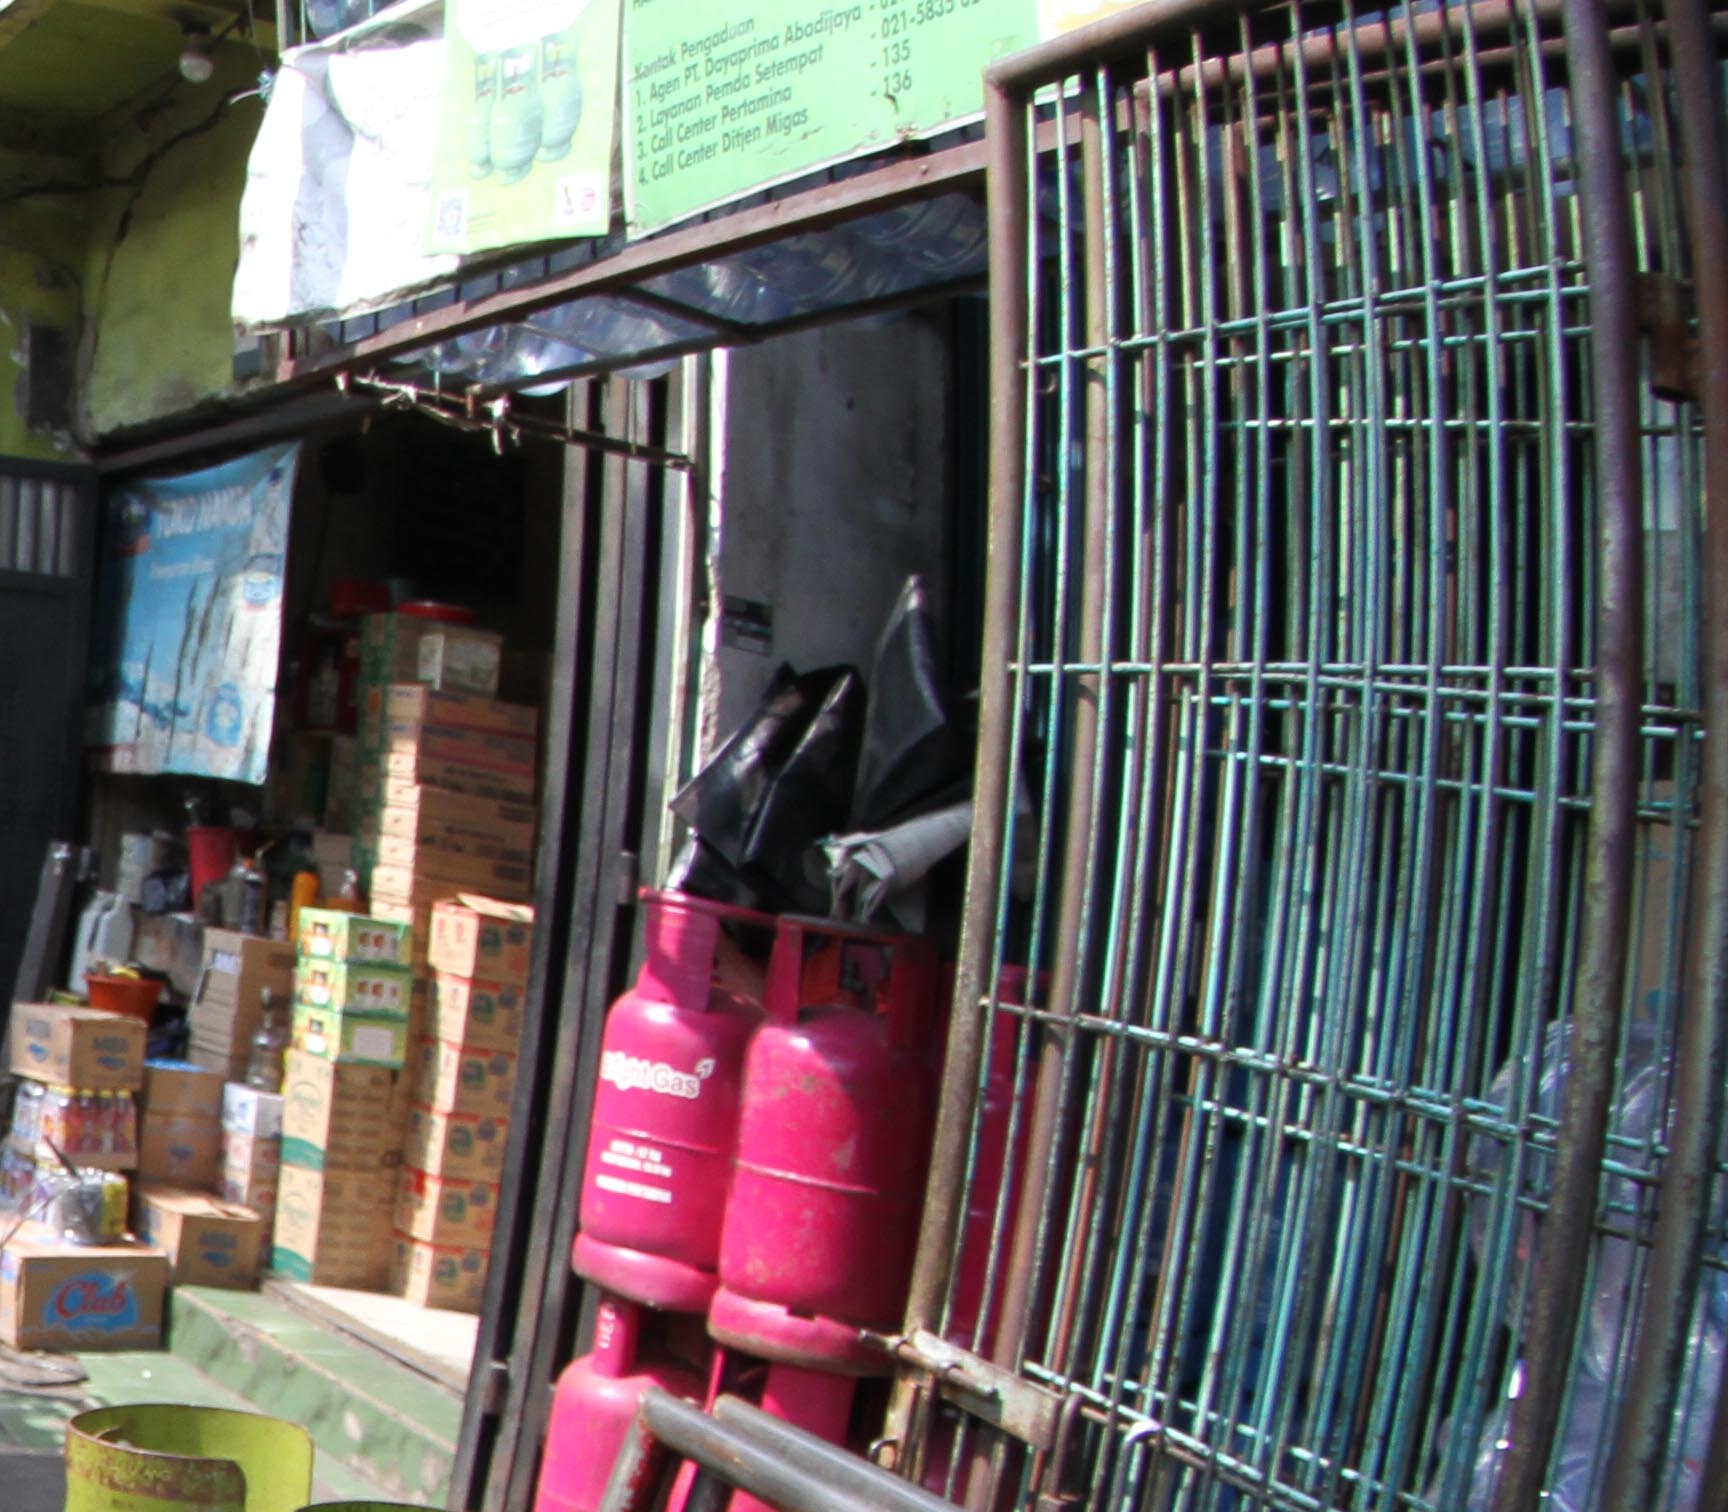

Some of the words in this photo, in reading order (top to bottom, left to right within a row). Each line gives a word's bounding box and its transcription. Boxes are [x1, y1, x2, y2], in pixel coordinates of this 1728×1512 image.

[650, 78, 681, 103] Agen
[705, 36, 780, 77] Dayaprima
[784, 8, 861, 46] Abadijaya
[681, 18, 755, 60] Pengaduan
[650, 94, 702, 128] Layanan
[706, 74, 751, 104] Pemda
[755, 44, 823, 84] Setempat
[651, 127, 673, 153] Call
[677, 115, 718, 143] Center
[722, 86, 792, 125] Pertamina
[883, 39, 911, 67] 135
[652, 154, 674, 181] Call
[678, 141, 718, 170] Center
[722, 126, 761, 152] Ditjen
[766, 109, 809, 136] Migas
[883, 69, 912, 95] 136
[55, 1281, 128, 1319] Club
